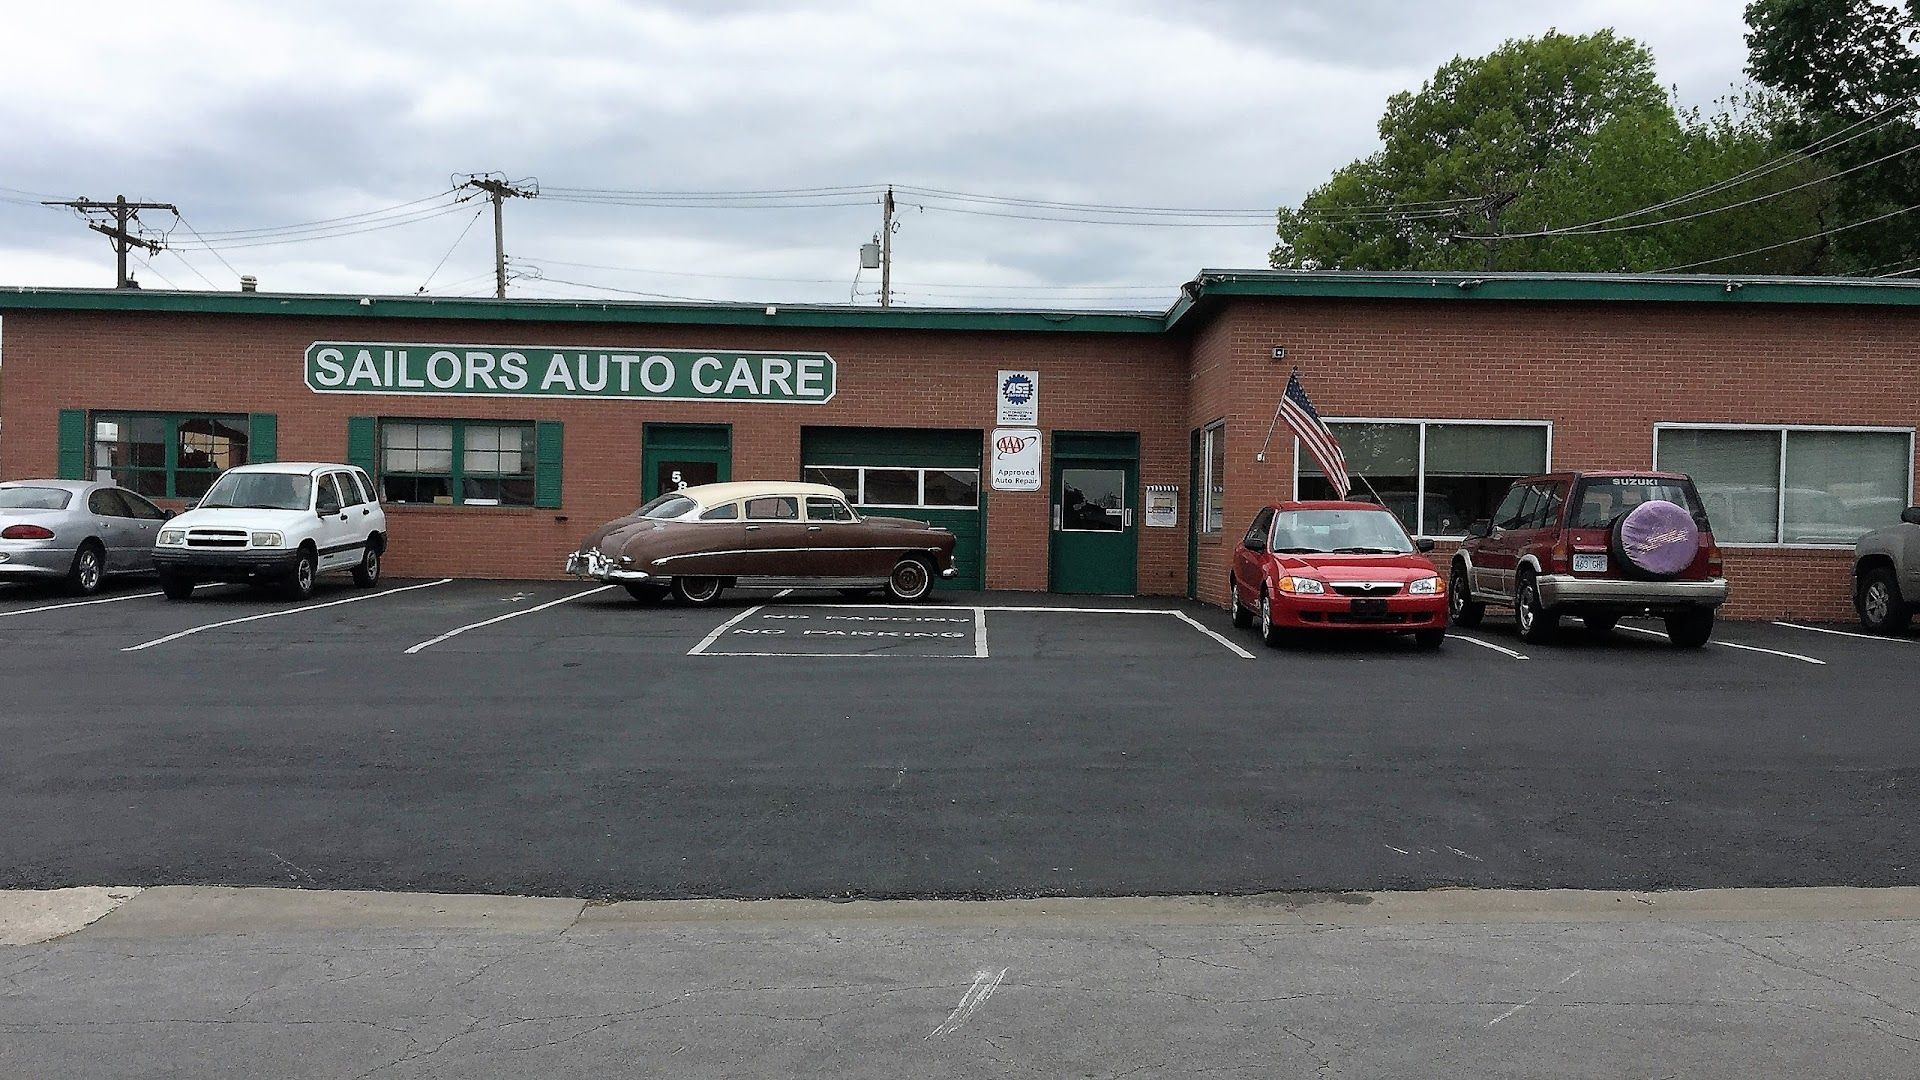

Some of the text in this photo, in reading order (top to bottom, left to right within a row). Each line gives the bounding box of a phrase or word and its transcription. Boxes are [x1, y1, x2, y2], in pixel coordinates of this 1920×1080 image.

[315, 348, 825, 396] SAILORS AUTO CARE
[1006, 382, 1030, 394] ASE
[999, 436, 1022, 454] AAA
[998, 468, 1035, 476] Approved
[1015, 477, 1038, 485] Repair
[1612, 478, 1658, 486] SUZUKI
[803, 629, 965, 638] PARKING
